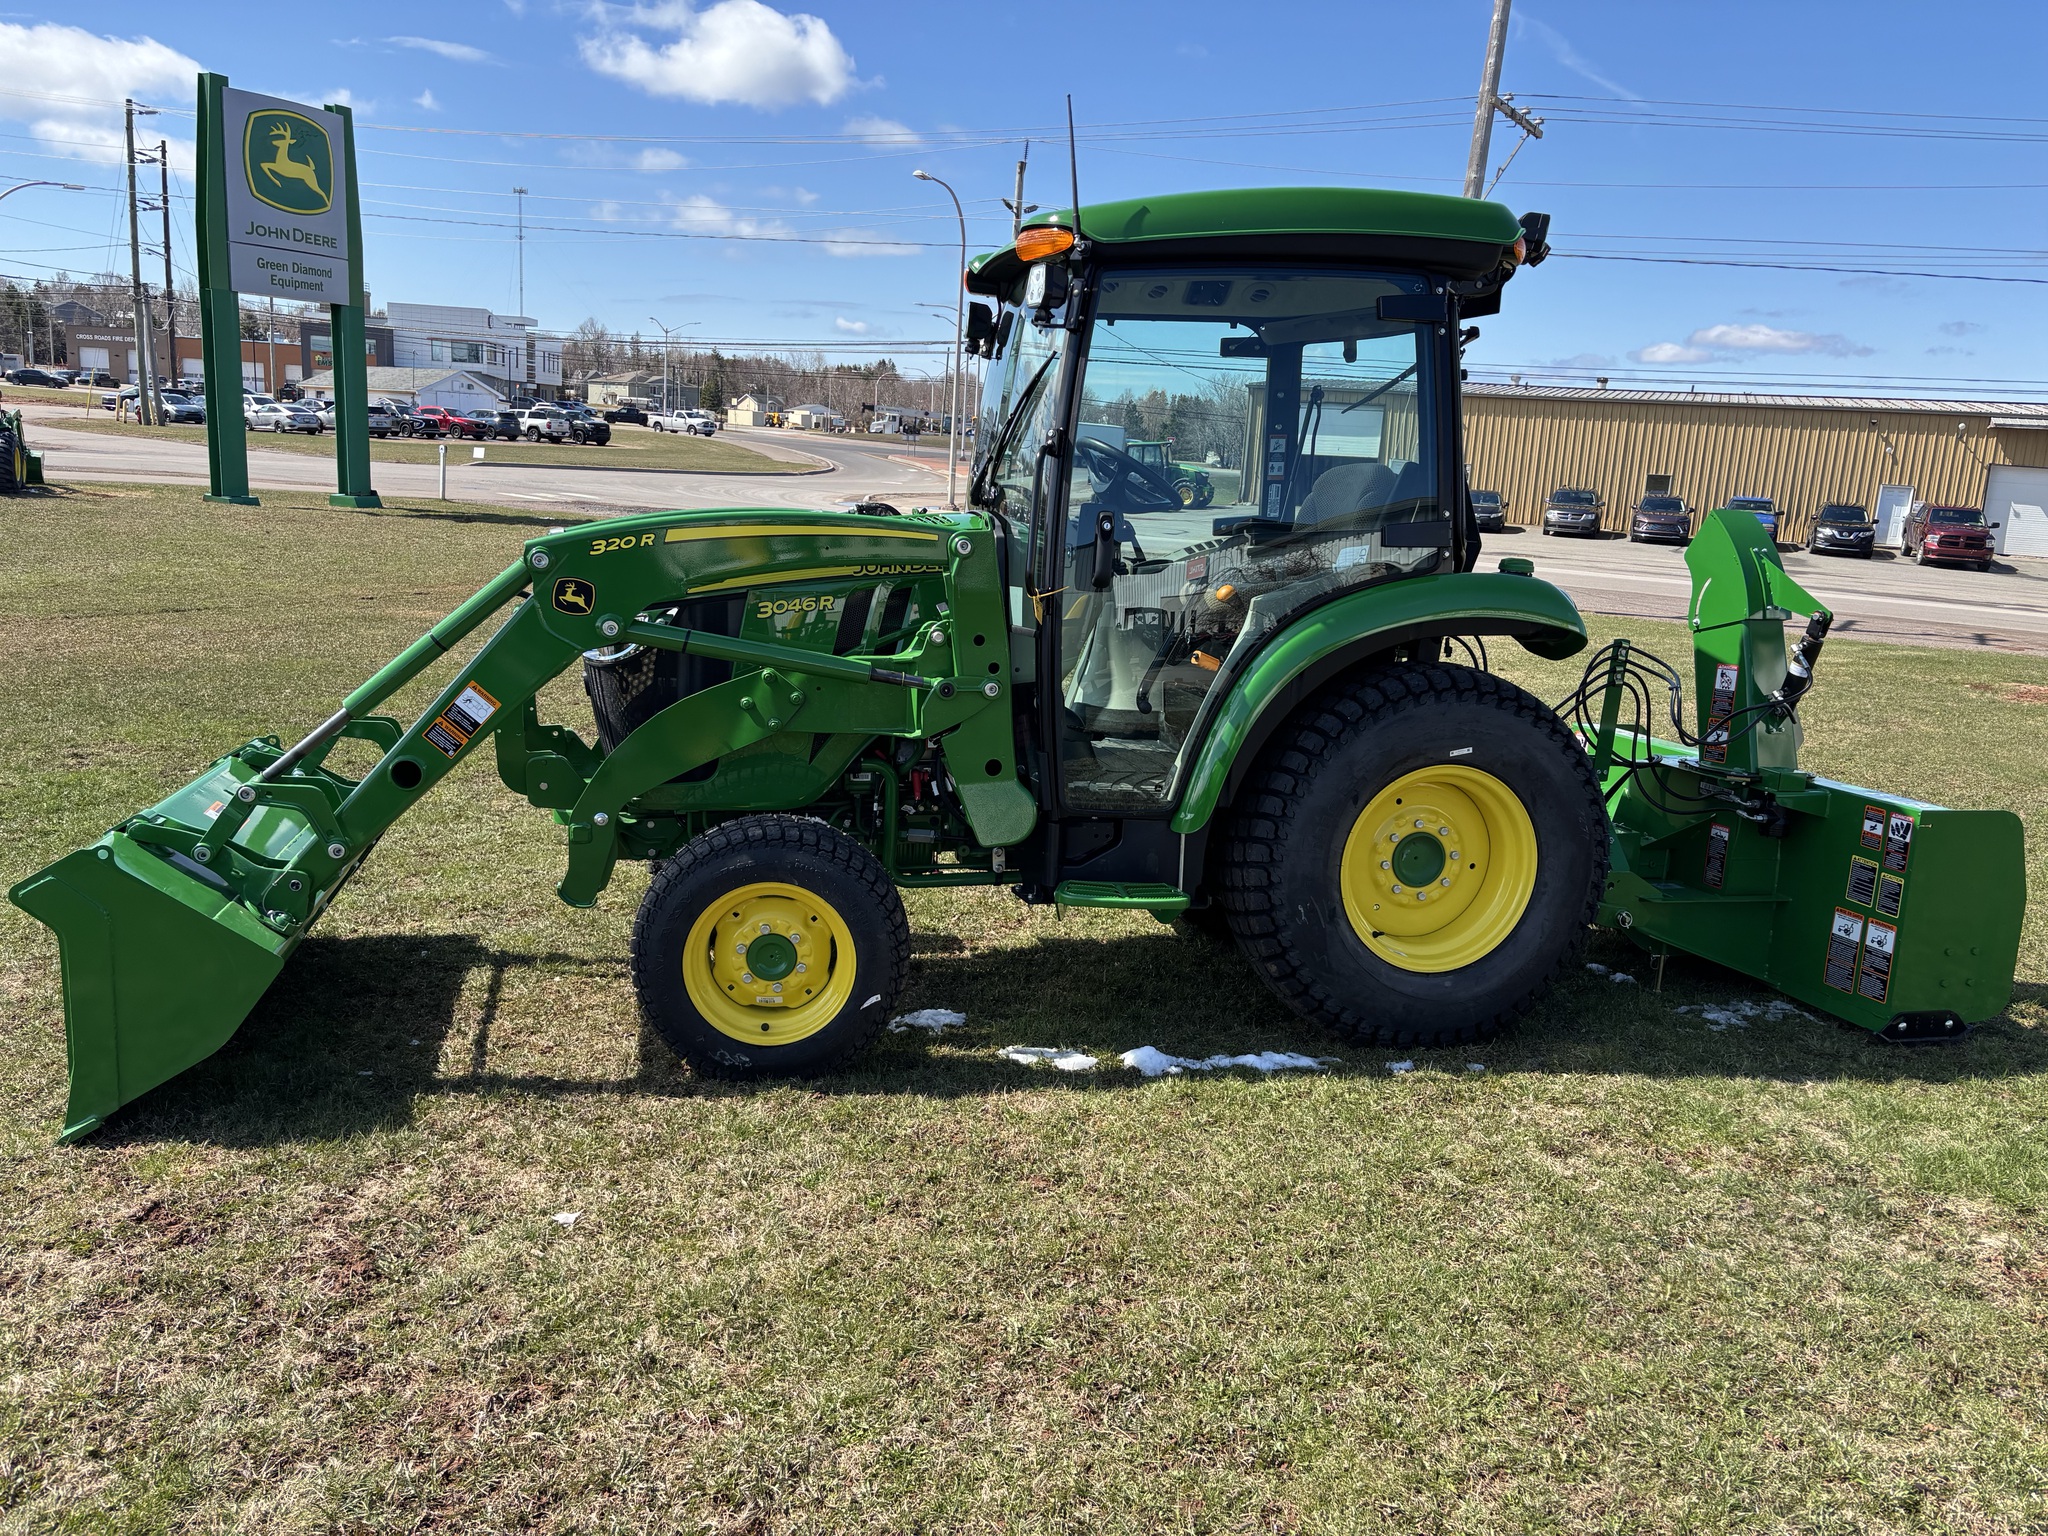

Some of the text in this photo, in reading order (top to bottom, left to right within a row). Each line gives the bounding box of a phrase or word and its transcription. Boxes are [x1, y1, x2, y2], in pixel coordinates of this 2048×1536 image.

[245, 221, 338, 249] JOHN DEERE
[256, 257, 332, 278] Green Diamond
[270, 274, 324, 292] Equipment
[588, 533, 656, 556] 320 R
[757, 597, 817, 619] 3046
[476, 689, 497, 706] WARNING
[443, 723, 464, 742] WARNING
